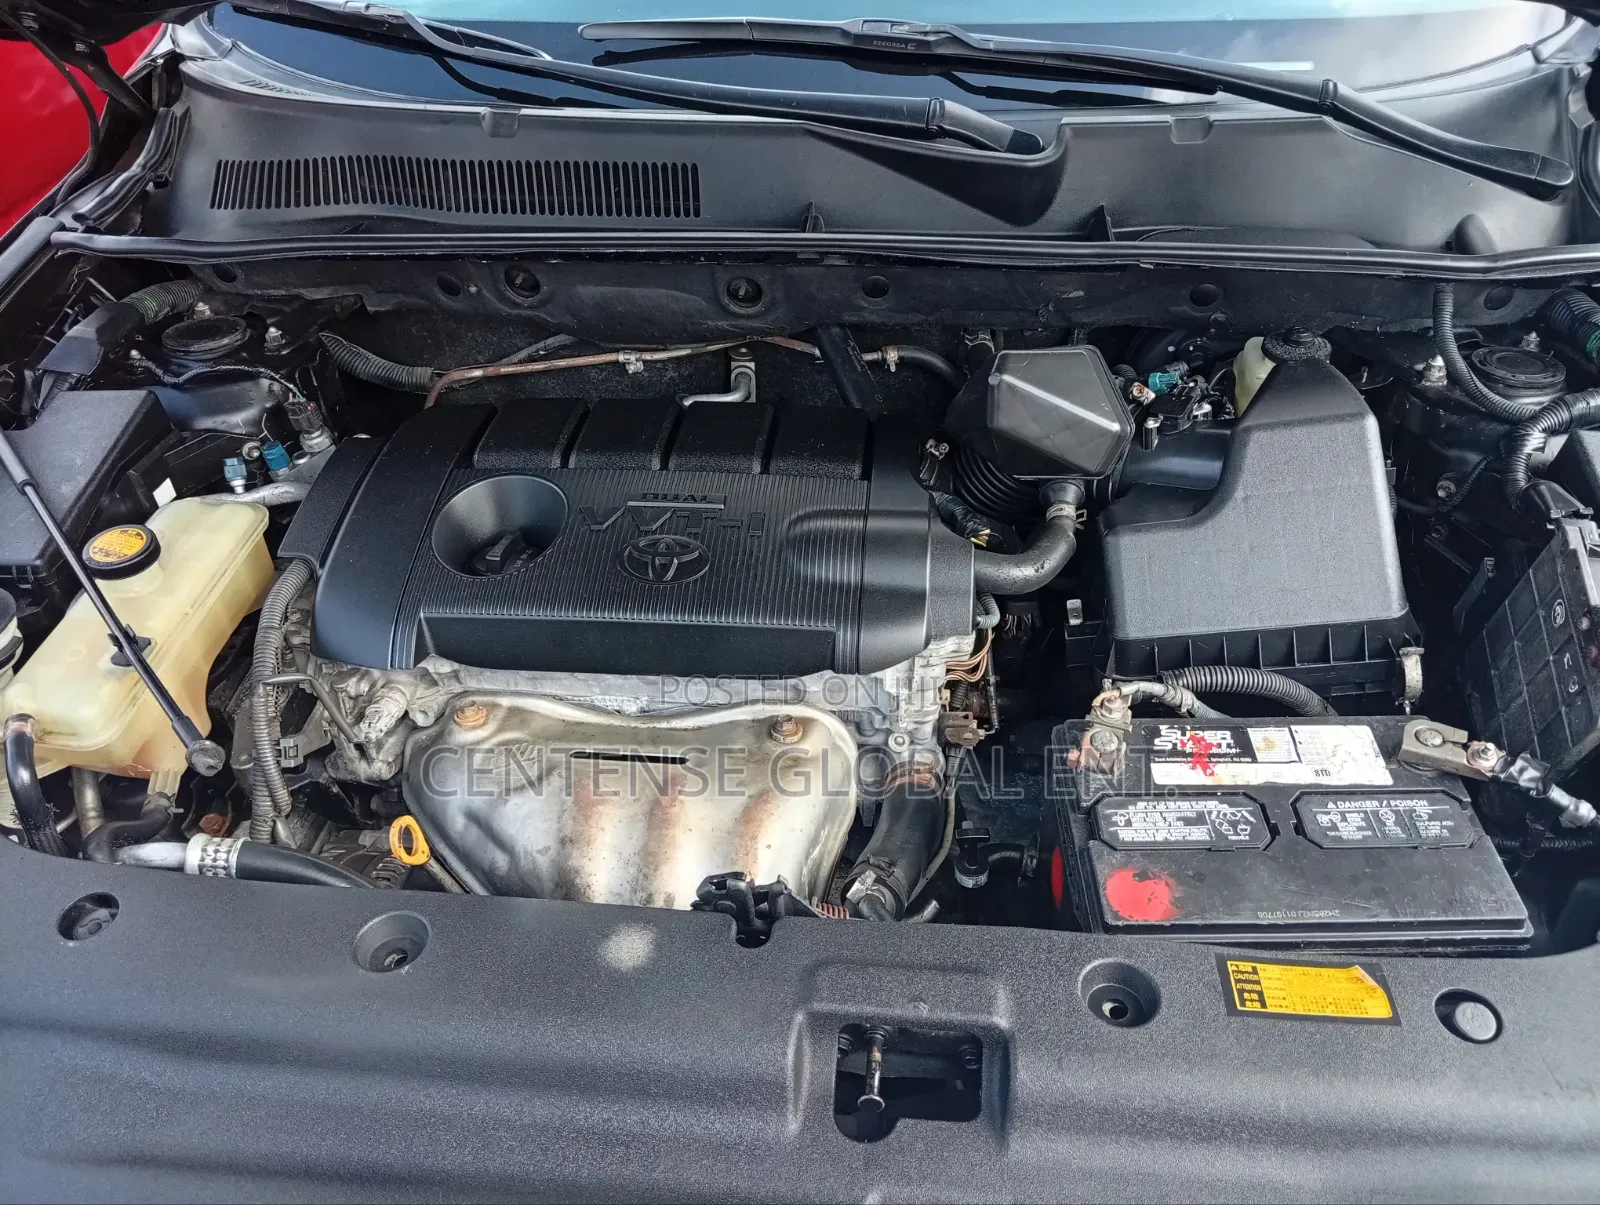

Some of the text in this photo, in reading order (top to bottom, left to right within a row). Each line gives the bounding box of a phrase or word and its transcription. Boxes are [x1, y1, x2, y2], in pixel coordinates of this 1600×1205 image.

[1160, 729, 1231, 741] SUPER
[1314, 769, 1331, 777] STD
[1337, 801, 1380, 809] DANGER
[1390, 799, 1428, 808] POISON
[1233, 972, 1260, 981] CAUTION
[1236, 982, 1262, 991] ATTENTION
